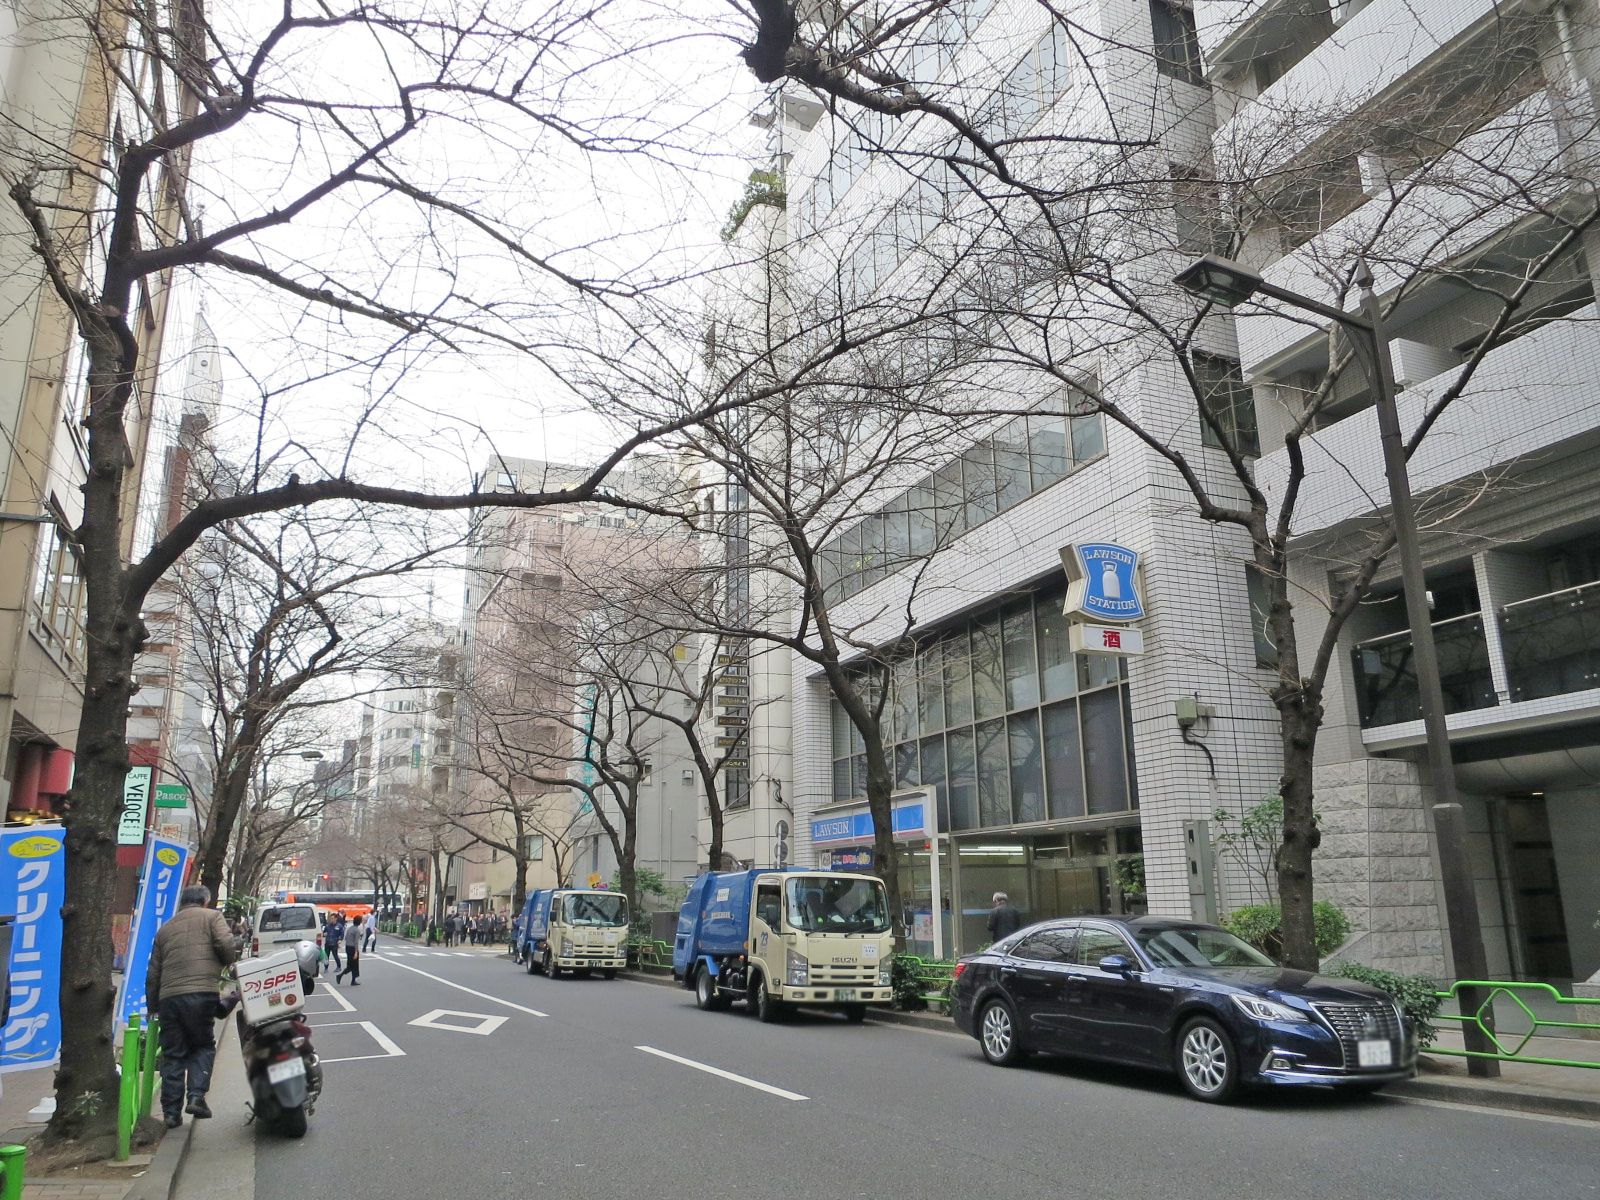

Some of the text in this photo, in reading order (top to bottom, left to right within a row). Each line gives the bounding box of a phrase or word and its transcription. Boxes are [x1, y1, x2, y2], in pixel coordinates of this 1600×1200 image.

[1084, 550, 1133, 565] LAWSON
[1088, 595, 1136, 610] STATION
[1102, 630, 1121, 649] 酒
[123, 783, 145, 824] VELOCE
[814, 820, 850, 838] LAWSON
[5, 860, 50, 1052] クリーニング
[263, 970, 297, 990] SPS
[274, 984, 296, 994] EXPRESS
